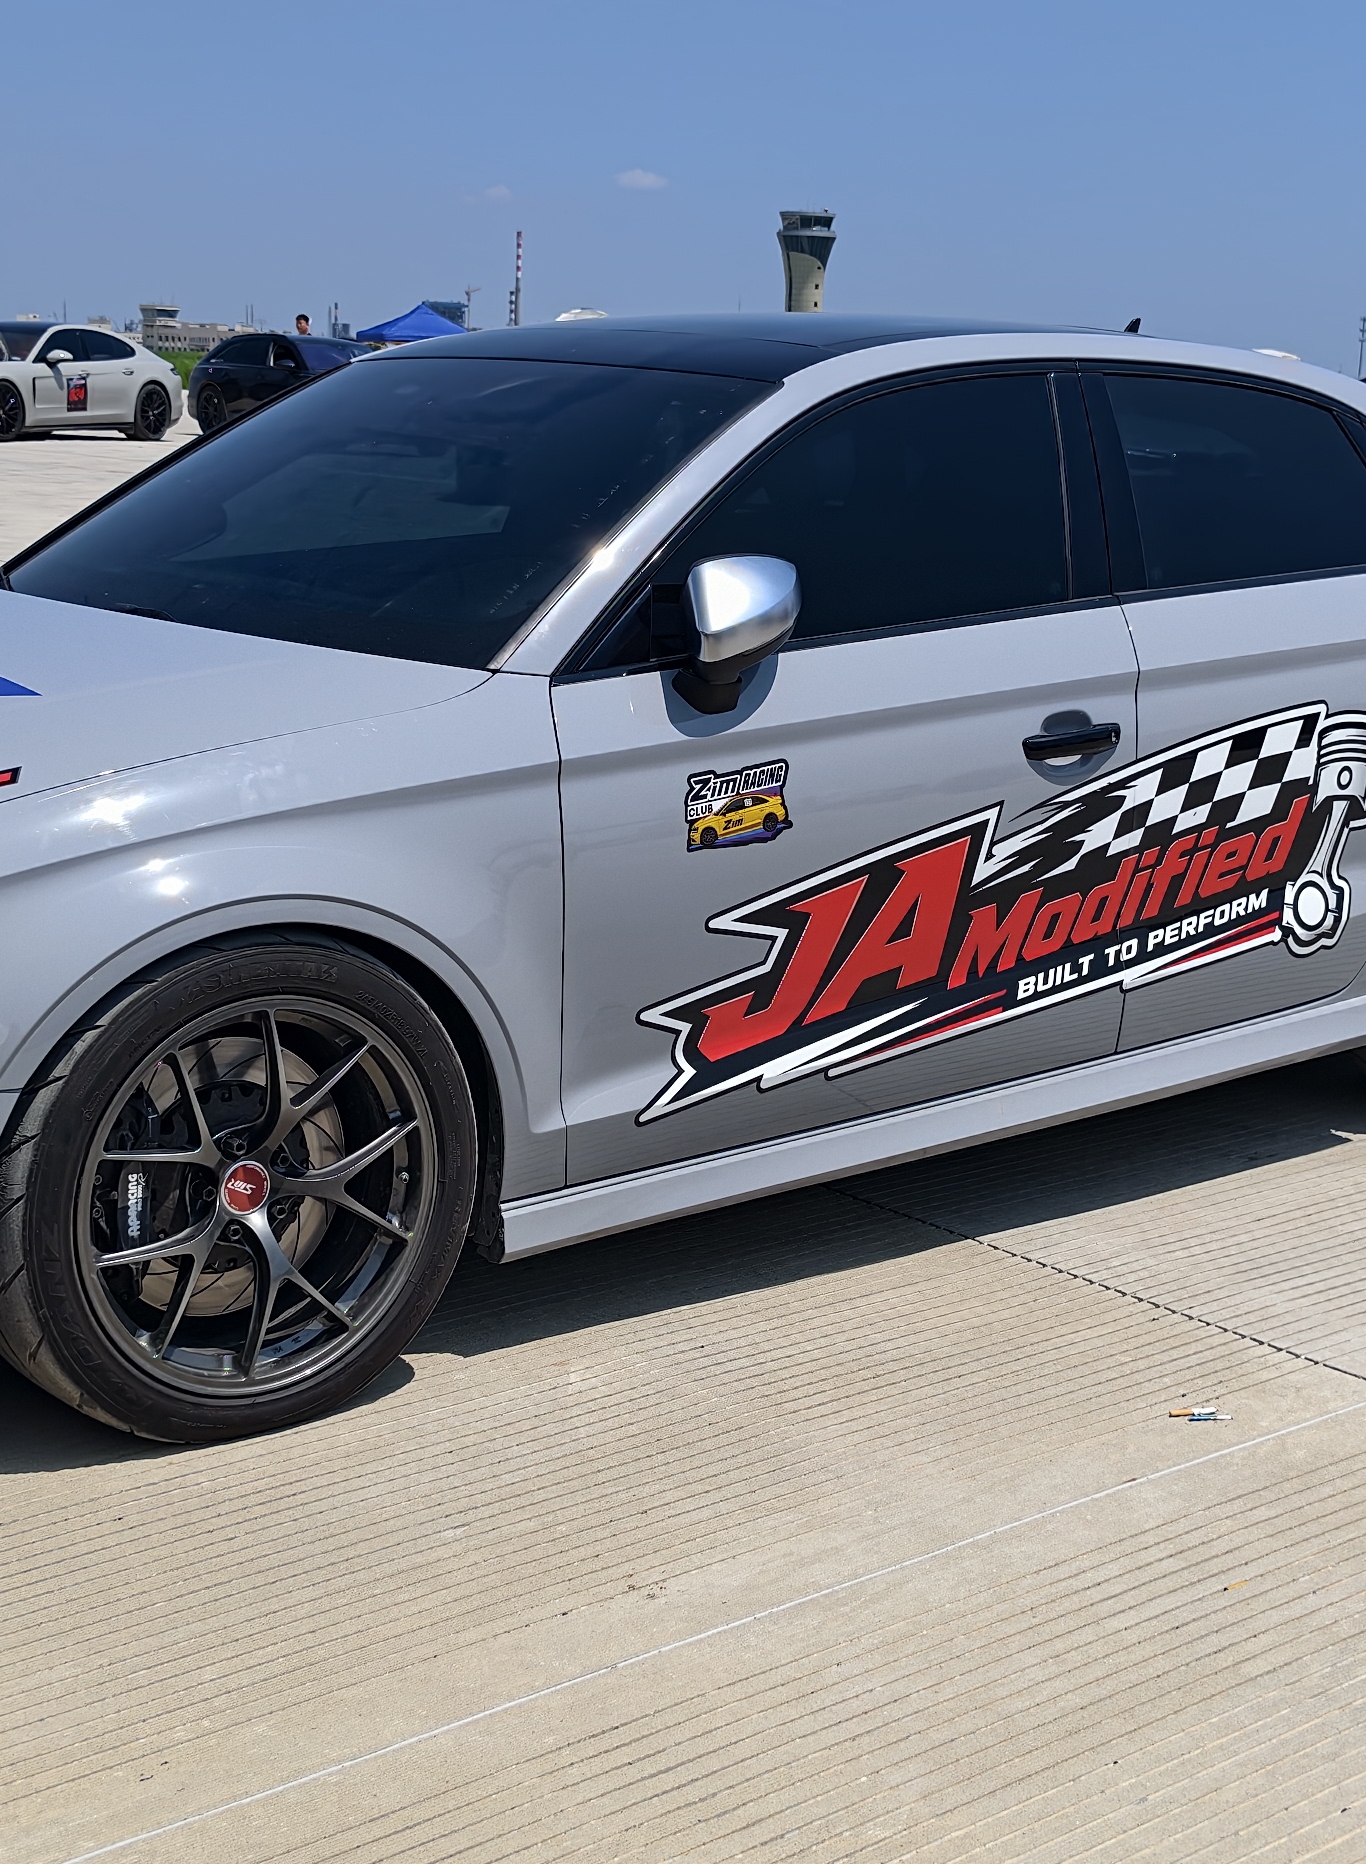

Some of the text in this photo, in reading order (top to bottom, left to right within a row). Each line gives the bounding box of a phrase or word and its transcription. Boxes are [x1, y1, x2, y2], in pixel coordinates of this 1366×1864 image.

[688, 764, 784, 804] Zim RACING
[688, 803, 714, 818] CLUB
[697, 795, 1311, 1063] JA Modified
[1017, 889, 1270, 1001] BUILT TO PERFORM
